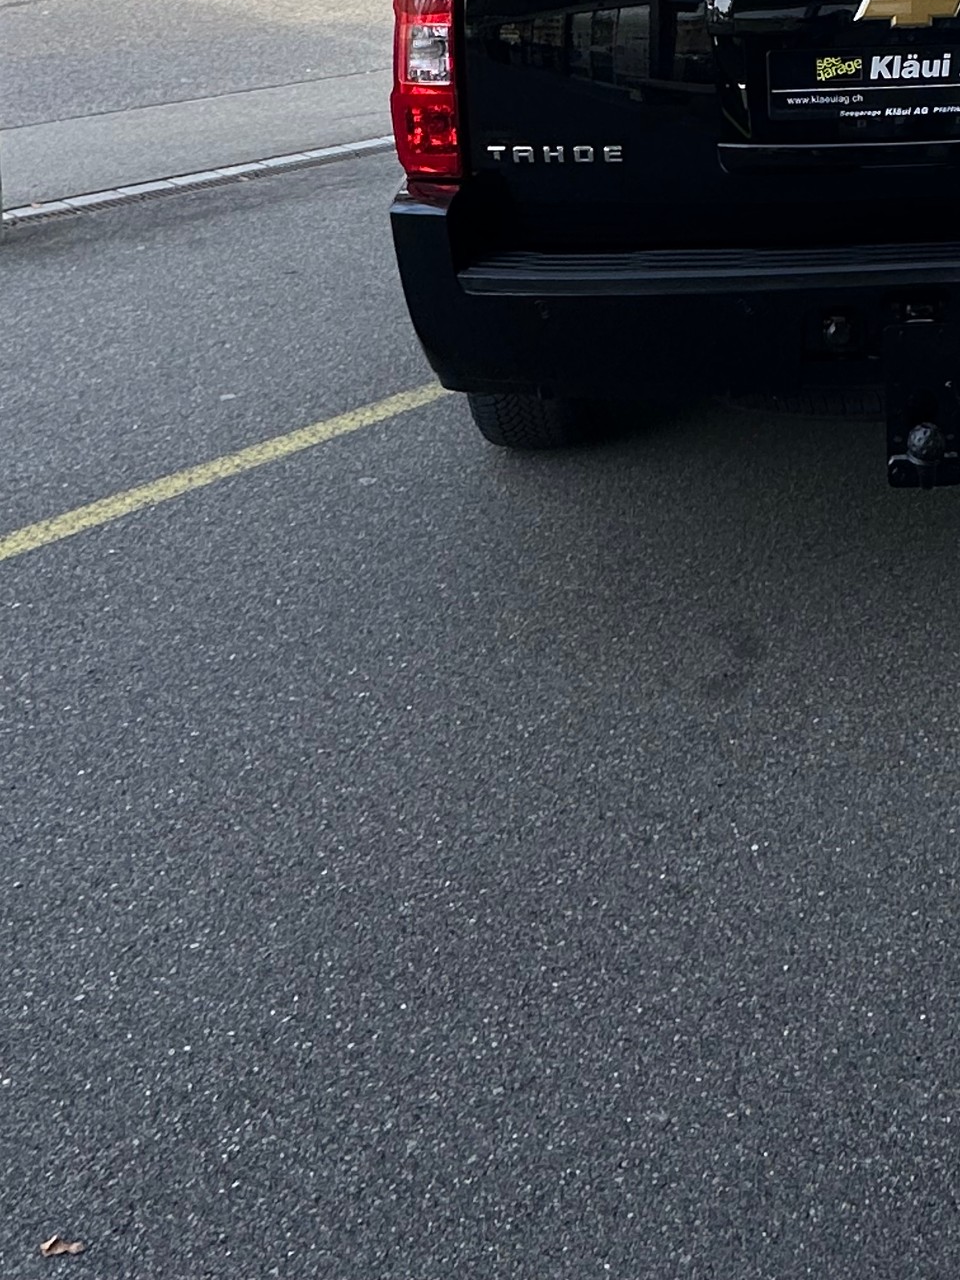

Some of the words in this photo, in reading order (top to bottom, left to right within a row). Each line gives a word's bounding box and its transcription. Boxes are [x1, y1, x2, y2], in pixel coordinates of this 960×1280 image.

[870, 54, 951, 80] Kläui
[885, 107, 911, 116] Kläui
[913, 106, 929, 115] AG
[487, 146, 623, 163] TAHOE
